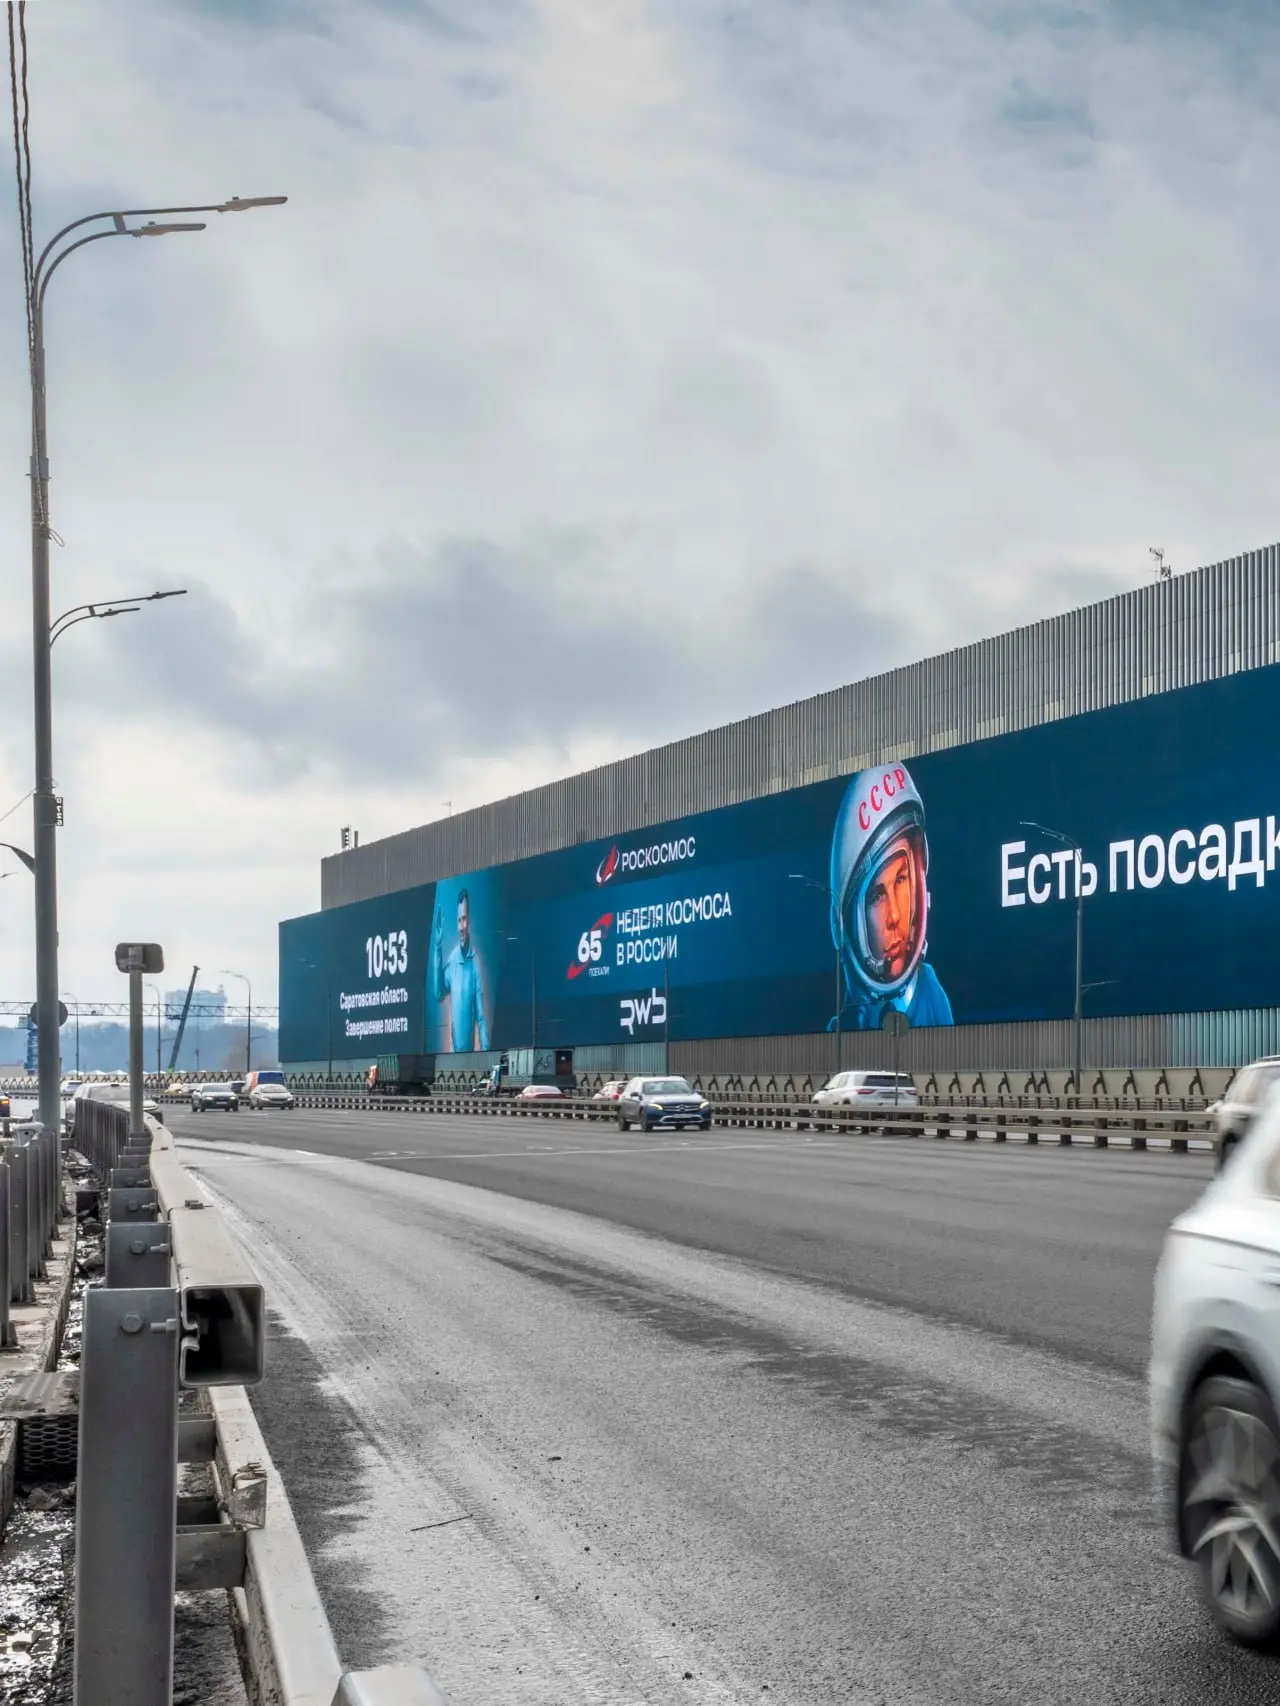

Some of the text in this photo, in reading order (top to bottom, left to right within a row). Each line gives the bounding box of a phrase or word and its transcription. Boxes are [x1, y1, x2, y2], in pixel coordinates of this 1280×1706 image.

[858, 768, 905, 830] СССР
[621, 836, 695, 872] РОСКОСМОС
[1001, 840, 1098, 908] Есть
[616, 892, 732, 937] НЕДЕЛЯ КОСМОСА
[366, 930, 408, 978] 10:53
[577, 929, 602, 963] 65
[616, 935, 677, 966] В РОССИИ
[340, 985, 408, 1013] Саратовская область
[345, 1017, 408, 1040] Завершение полета
